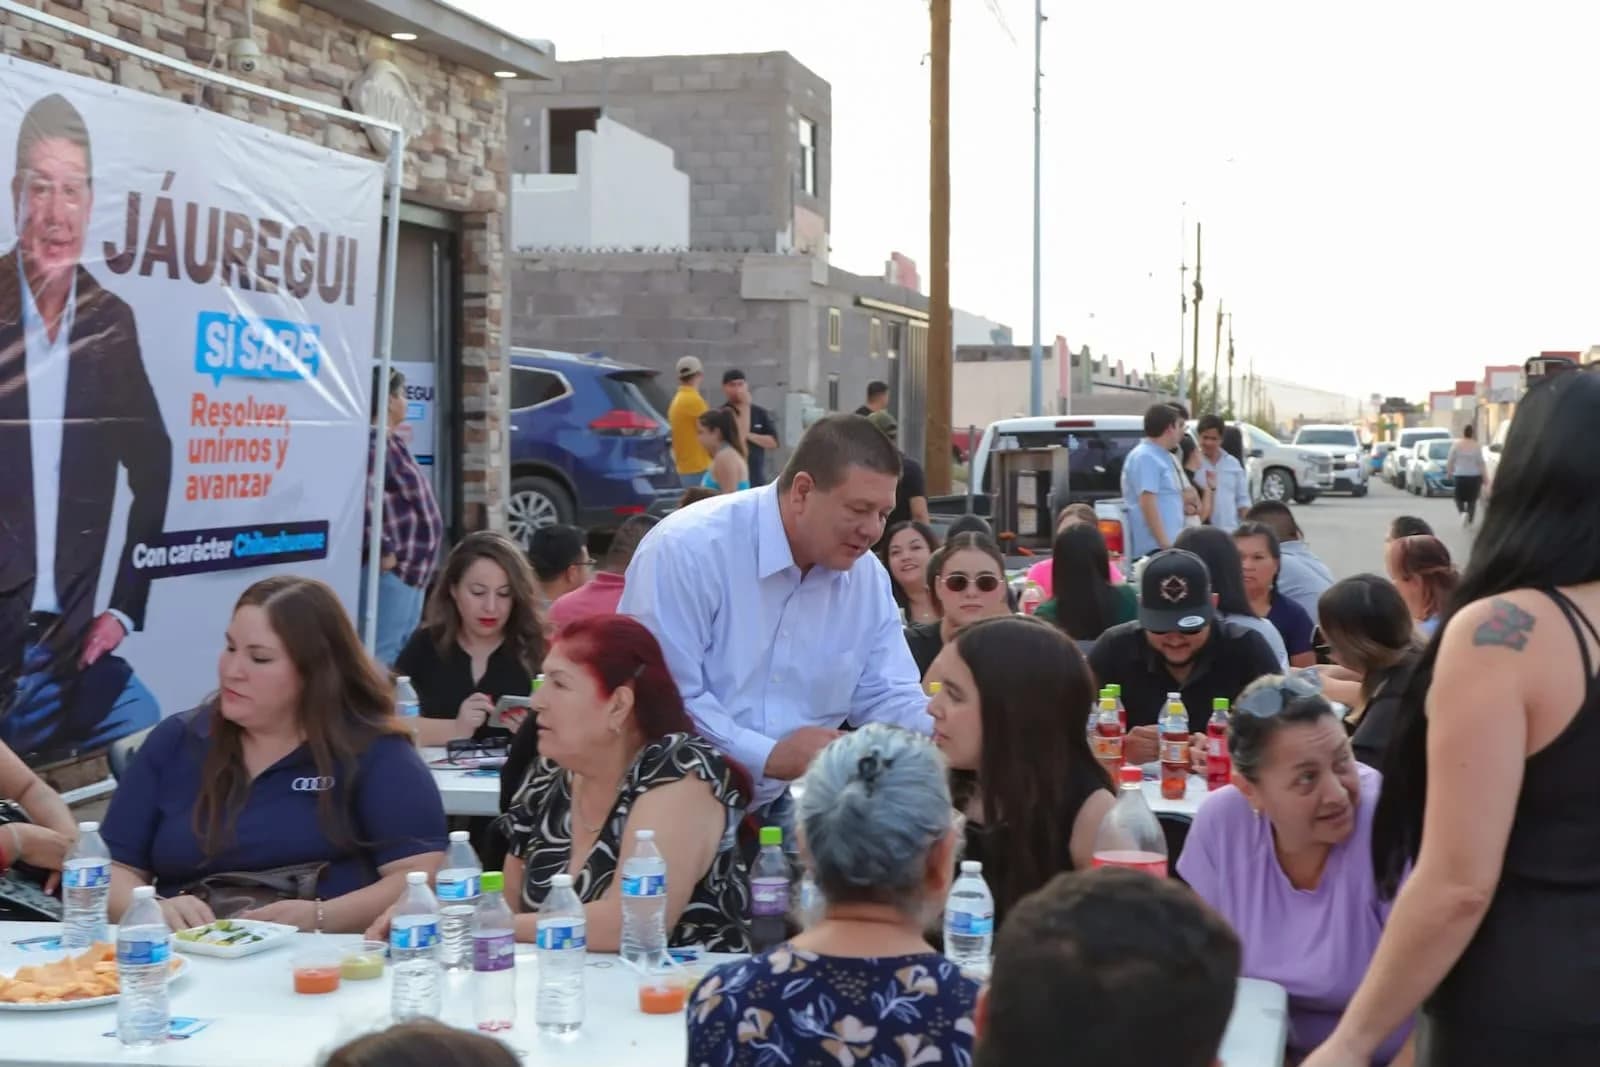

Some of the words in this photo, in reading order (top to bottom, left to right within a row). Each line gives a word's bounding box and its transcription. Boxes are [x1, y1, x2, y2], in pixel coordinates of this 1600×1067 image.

[102, 170, 358, 306] JÁUREGUI
[191, 392, 290, 436] Resolver,
[188, 427, 272, 464] unirnos
[275, 438, 289, 470] y
[185, 472, 273, 501] avanzar
[132, 543, 167, 569] Con
[168, 535, 234, 565] carácter
